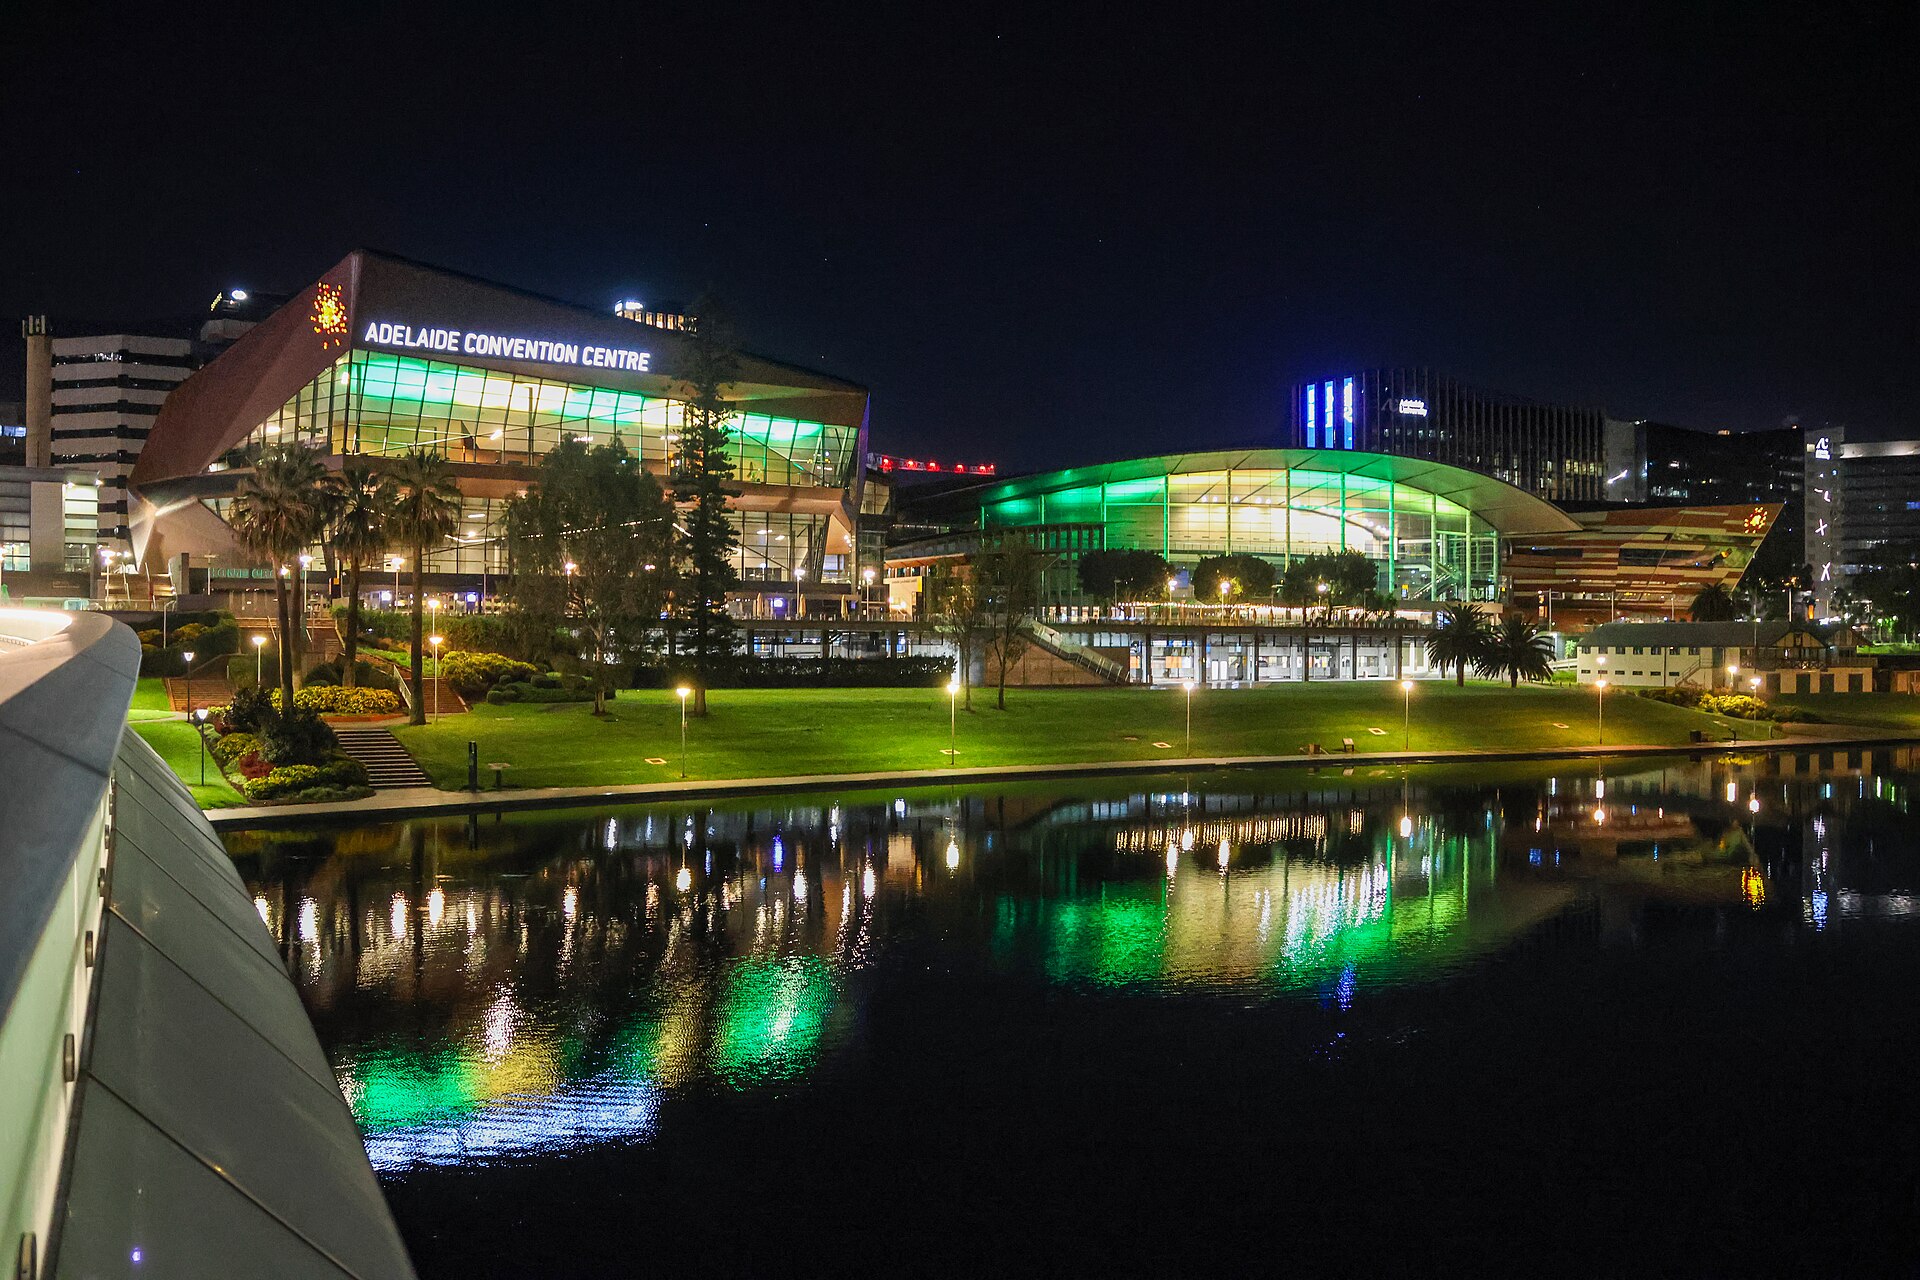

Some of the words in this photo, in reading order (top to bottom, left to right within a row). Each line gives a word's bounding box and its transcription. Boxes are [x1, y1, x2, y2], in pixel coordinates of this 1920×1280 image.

[365, 322, 460, 352] ADELAIDE
[464, 333, 577, 363] CONVENTION
[582, 346, 650, 371] CENTRE
